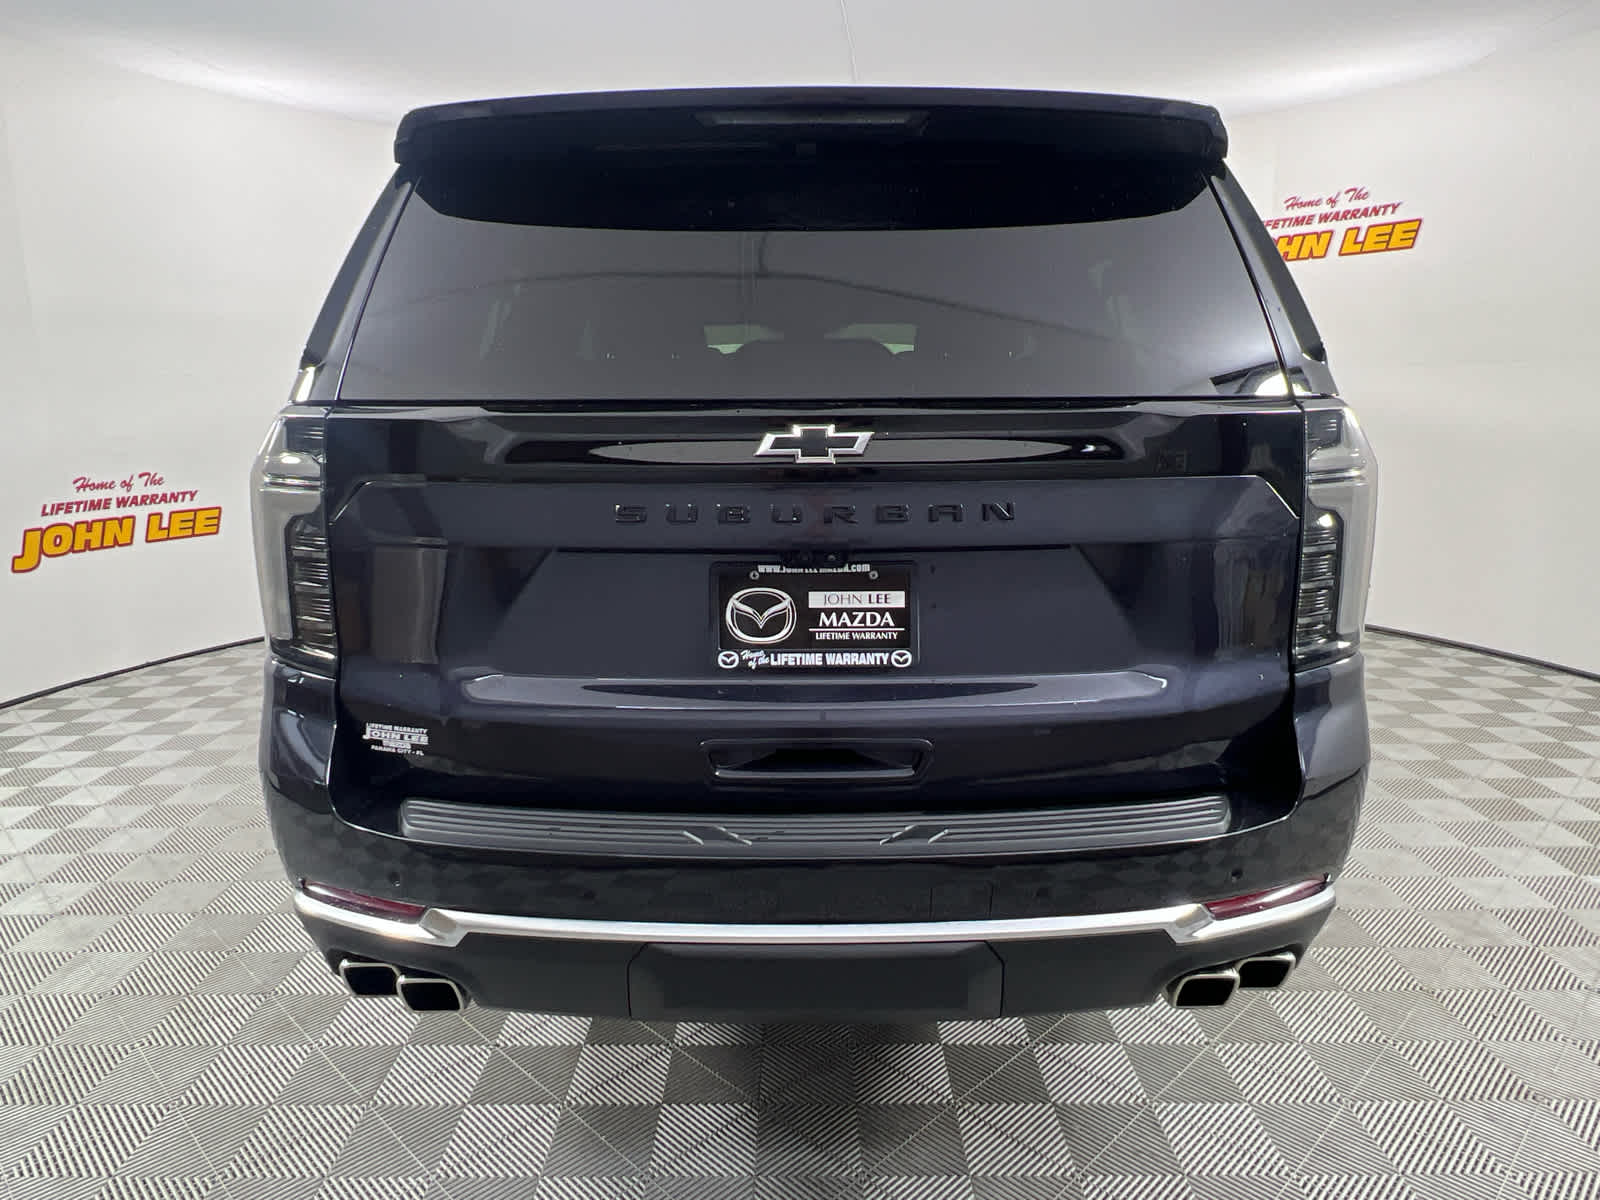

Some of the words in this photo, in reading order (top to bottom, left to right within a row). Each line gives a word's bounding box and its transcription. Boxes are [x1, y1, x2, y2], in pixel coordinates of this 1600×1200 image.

[1284, 196, 1321, 210] Home
[1326, 192, 1340, 208] of
[1344, 186, 1369, 202] The
[1264, 214, 1314, 229] FETIME
[1318, 202, 1401, 223] WARRANTY
[1274, 230, 1333, 261] HN
[1339, 219, 1422, 256] LEE
[73, 476, 116, 492] Home
[120, 475, 134, 492] of
[138, 472, 165, 487] The
[41, 498, 113, 517] LIFETIME
[115, 490, 199, 509] WARRANTY
[614, 502, 1016, 525] SUBURBAN
[11, 515, 136, 573] JOHN
[145, 506, 222, 543] LEE
[824, 594, 862, 605] JOHN
[868, 594, 892, 604] LEE
[818, 611, 895, 627] MAZDA
[815, 632, 850, 640] LIFETIME
[851, 631, 898, 640] WARRANTY
[770, 653, 823, 666] LIFETIME
[825, 653, 890, 666] WARRANTY
